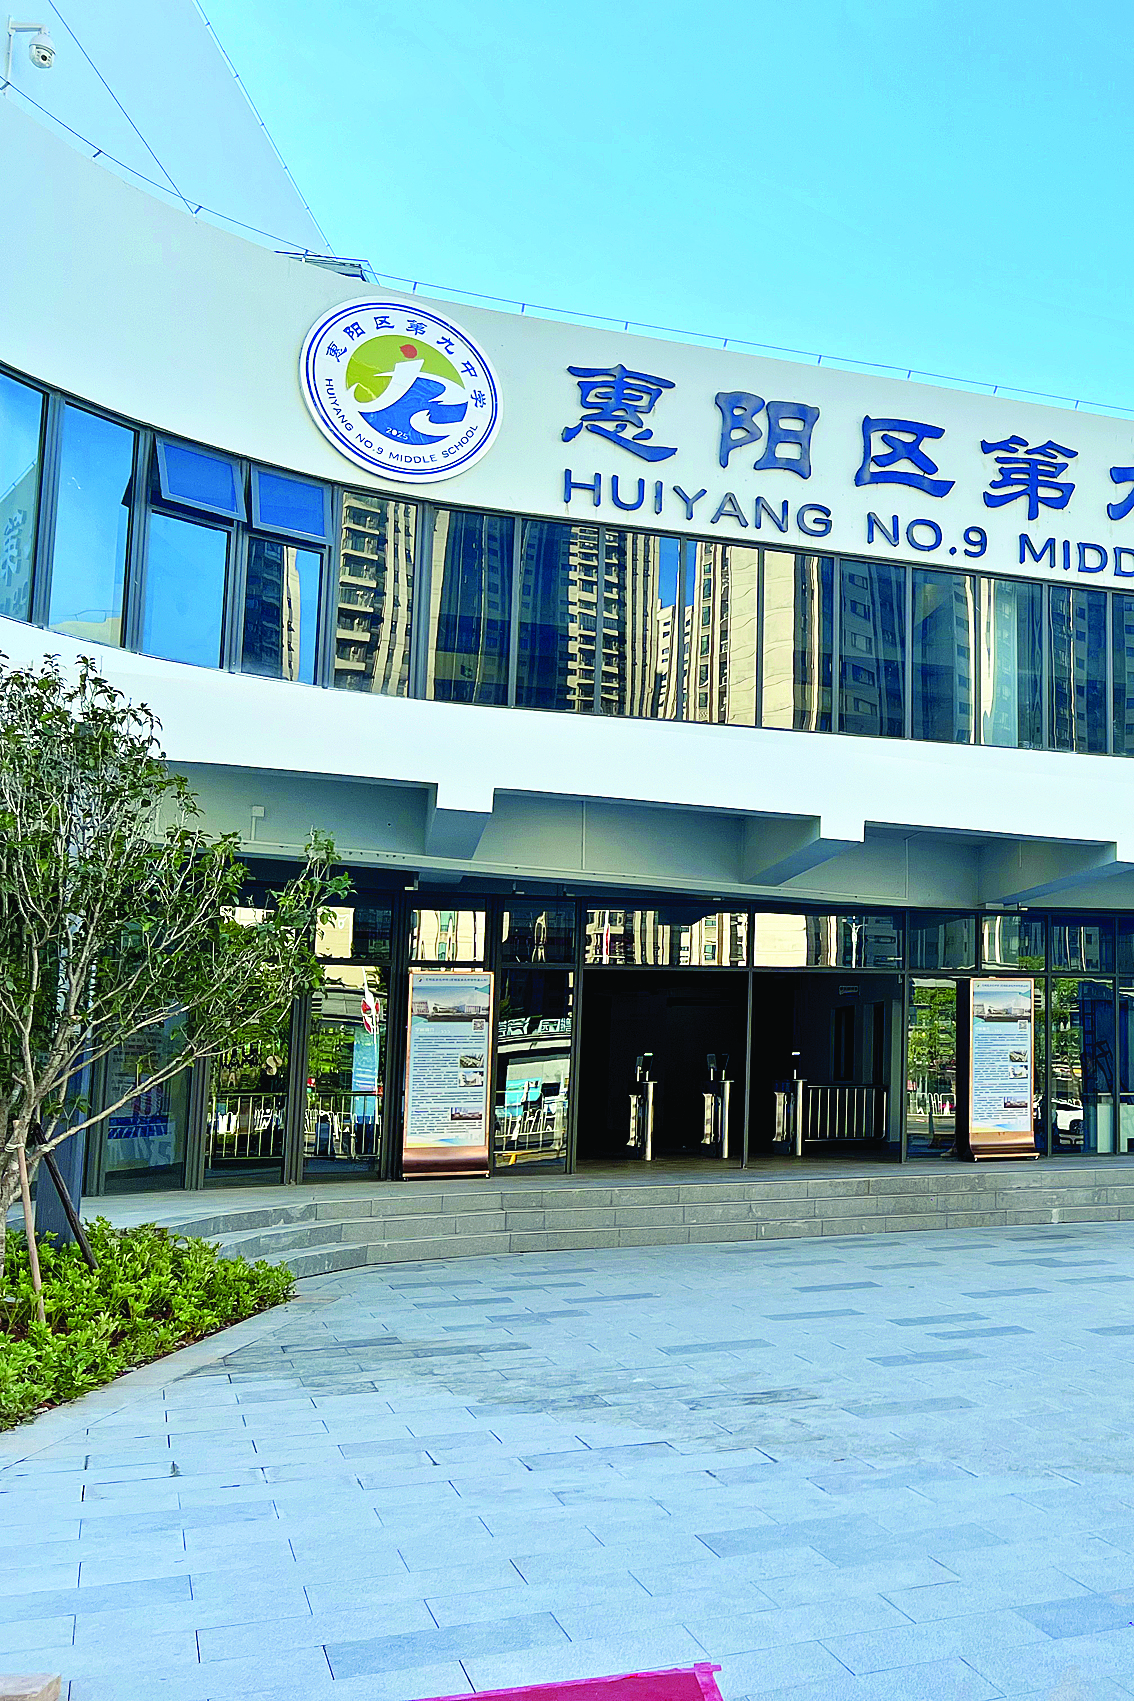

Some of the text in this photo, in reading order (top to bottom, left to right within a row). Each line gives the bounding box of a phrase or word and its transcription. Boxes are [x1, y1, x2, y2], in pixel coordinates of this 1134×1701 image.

[326, 315, 487, 409] 惠阳区第九中学
[325, 378, 478, 464] HUIYANG NO.9 MIDDLE SCHOOL
[564, 468, 833, 538] HUIYANG
[867, 511, 988, 558] NO.9
